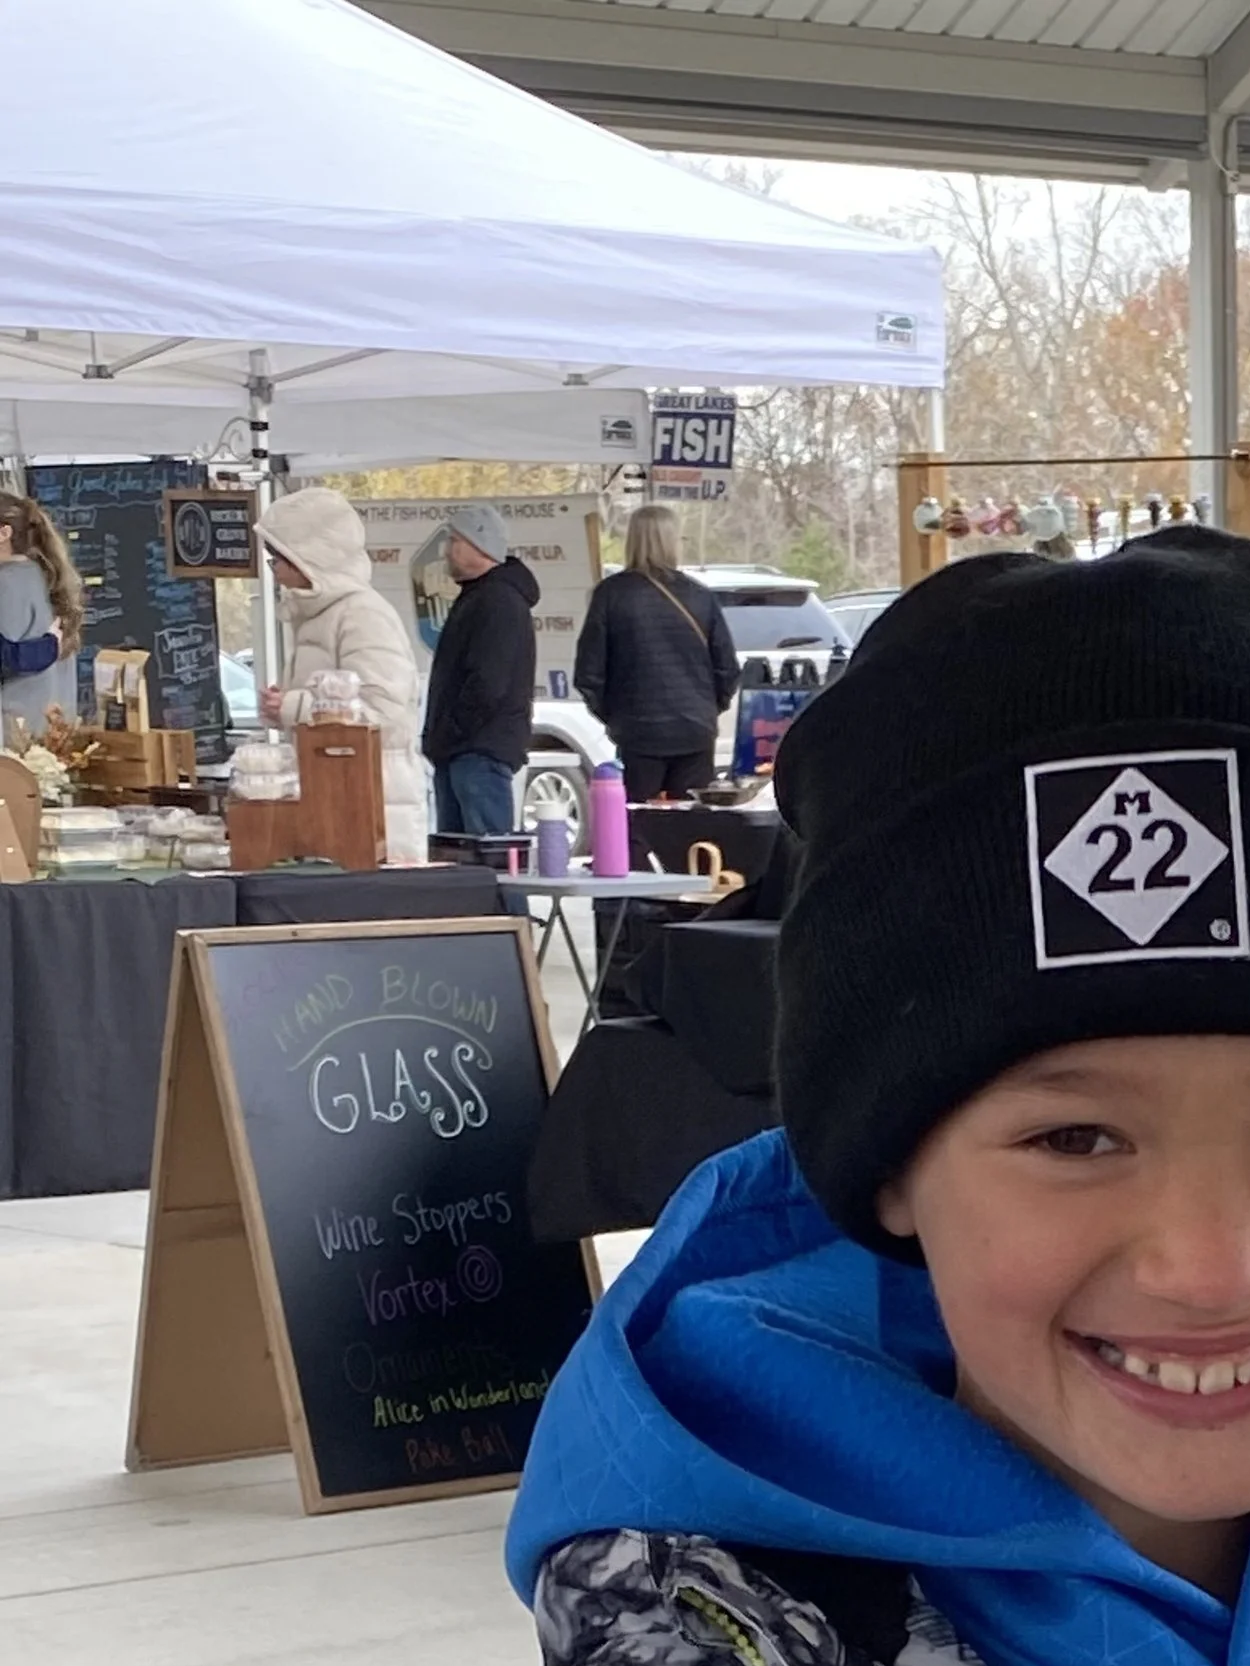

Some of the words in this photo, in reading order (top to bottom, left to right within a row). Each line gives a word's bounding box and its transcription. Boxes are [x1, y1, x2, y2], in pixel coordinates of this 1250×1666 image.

[695, 396, 735, 410] LAKES
[654, 418, 731, 462] FISH
[369, 506, 392, 521] THE
[393, 506, 418, 521] FISH
[514, 503, 555, 518] HOUSE
[546, 617, 574, 632] FISH
[1113, 790, 1152, 816] M
[1085, 819, 1191, 894] 22
[272, 973, 354, 1052] HAND
[380, 964, 498, 1033] BLOWN
[309, 1041, 490, 1139] GLASS
[313, 1207, 384, 1260] Wine
[391, 1190, 511, 1246] Stoppers
[357, 1265, 459, 1327] Vortex
[372, 1394, 425, 1429] Alice
[429, 1387, 452, 1417] in
